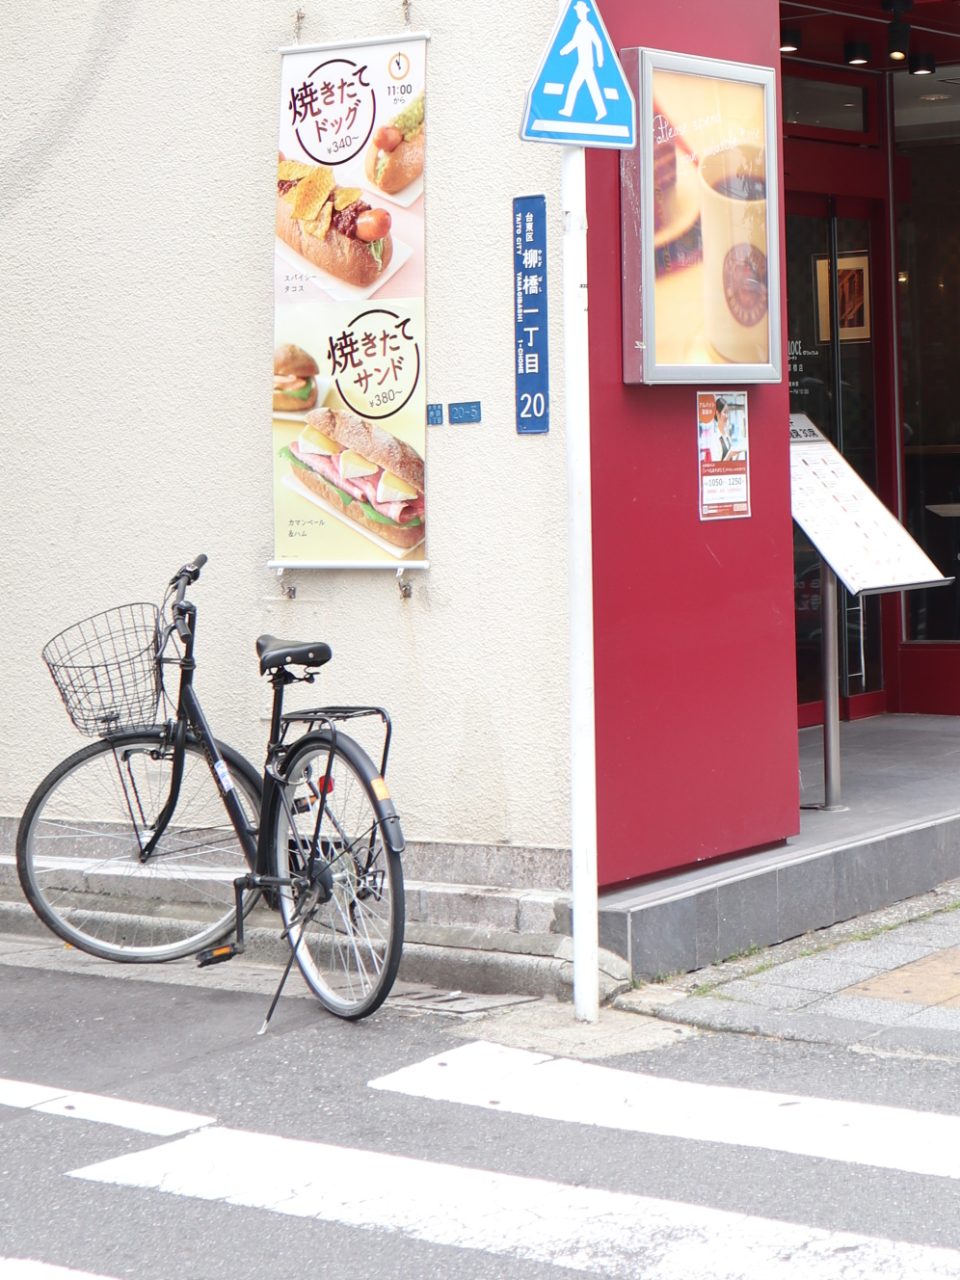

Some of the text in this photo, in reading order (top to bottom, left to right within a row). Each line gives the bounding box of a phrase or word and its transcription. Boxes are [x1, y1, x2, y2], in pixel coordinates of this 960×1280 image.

[288, 65, 370, 126] 焼きたて
[387, 84, 413, 96] 11:00
[315, 99, 362, 143] ドッグ
[327, 318, 414, 376] 焼きたて
[353, 356, 404, 394] サンド
[520, 393, 545, 418] 20
